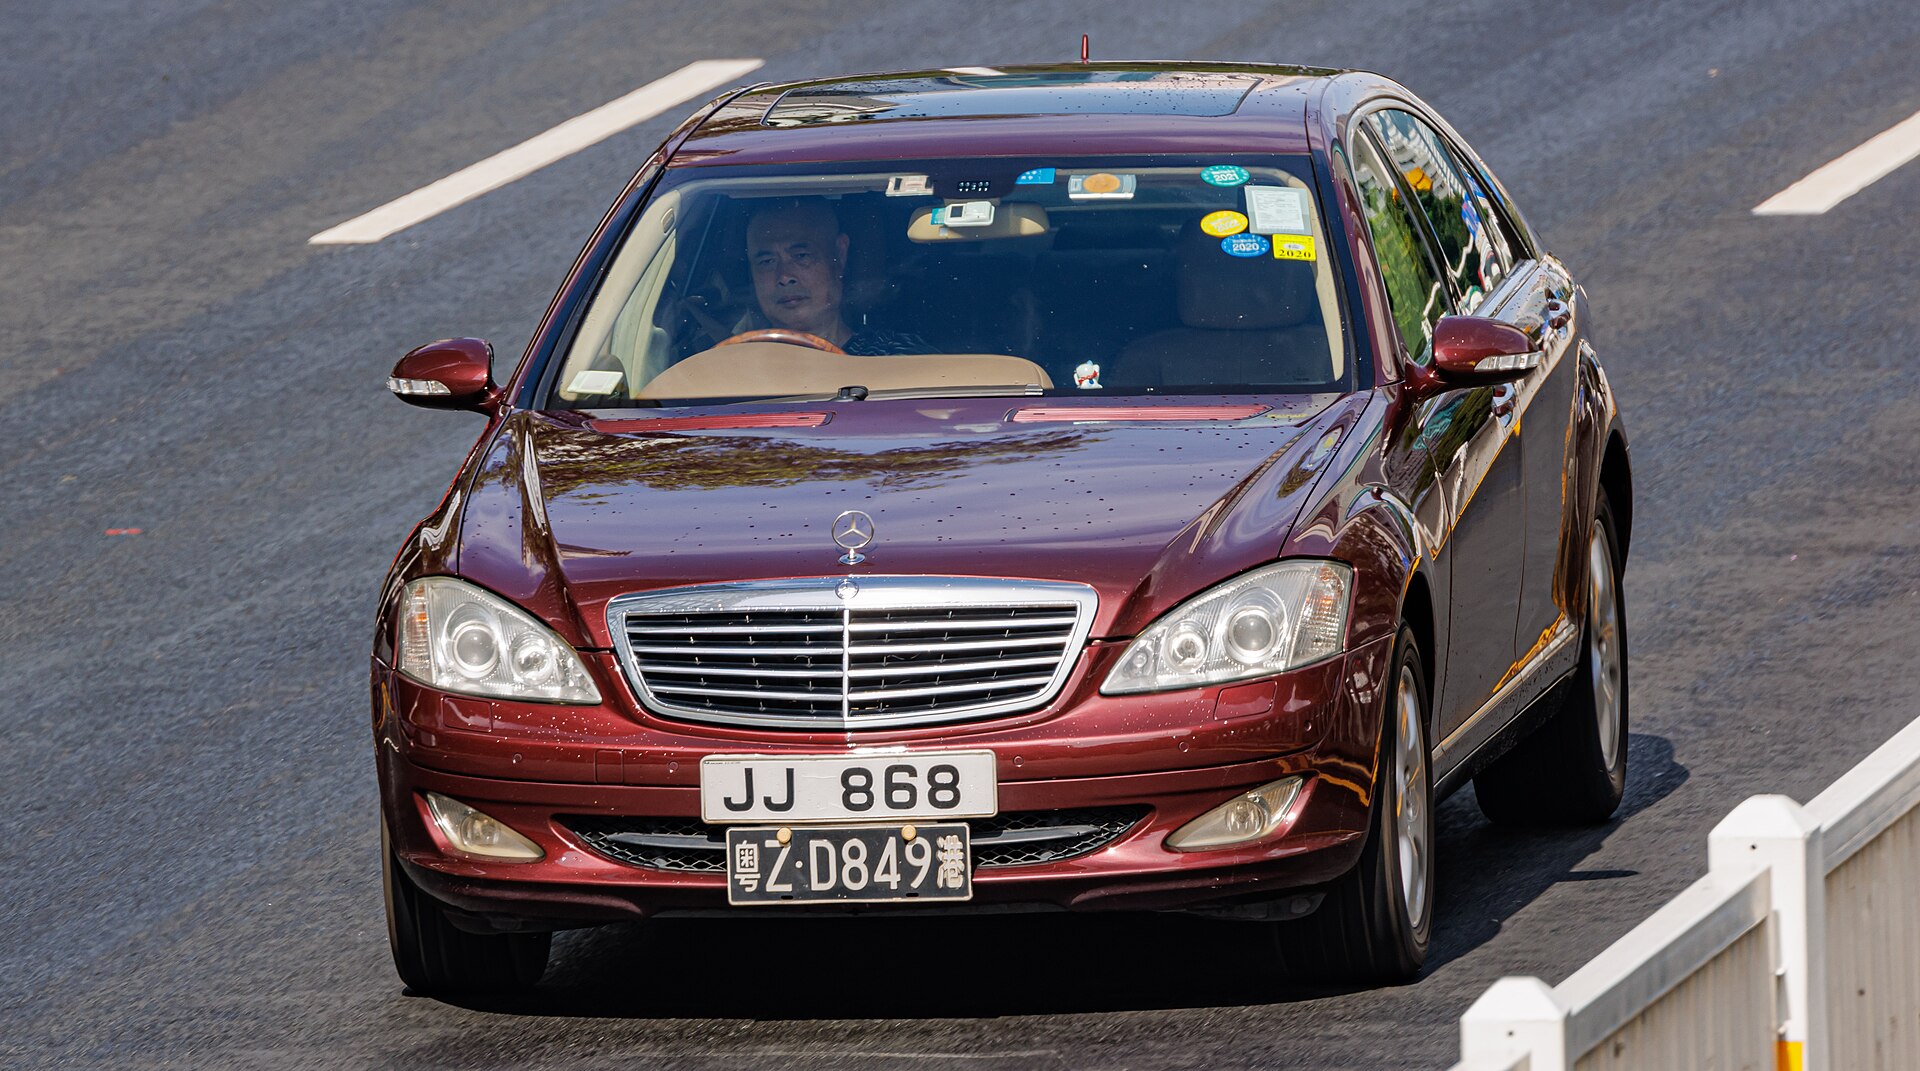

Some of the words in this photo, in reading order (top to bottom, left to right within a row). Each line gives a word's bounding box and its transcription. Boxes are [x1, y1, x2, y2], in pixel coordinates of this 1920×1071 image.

[1213, 173, 1239, 182] 2021
[1232, 242, 1260, 252] 2020
[1279, 249, 1311, 258] 2020
[723, 767, 795, 812] JJ
[840, 764, 961, 812] 868
